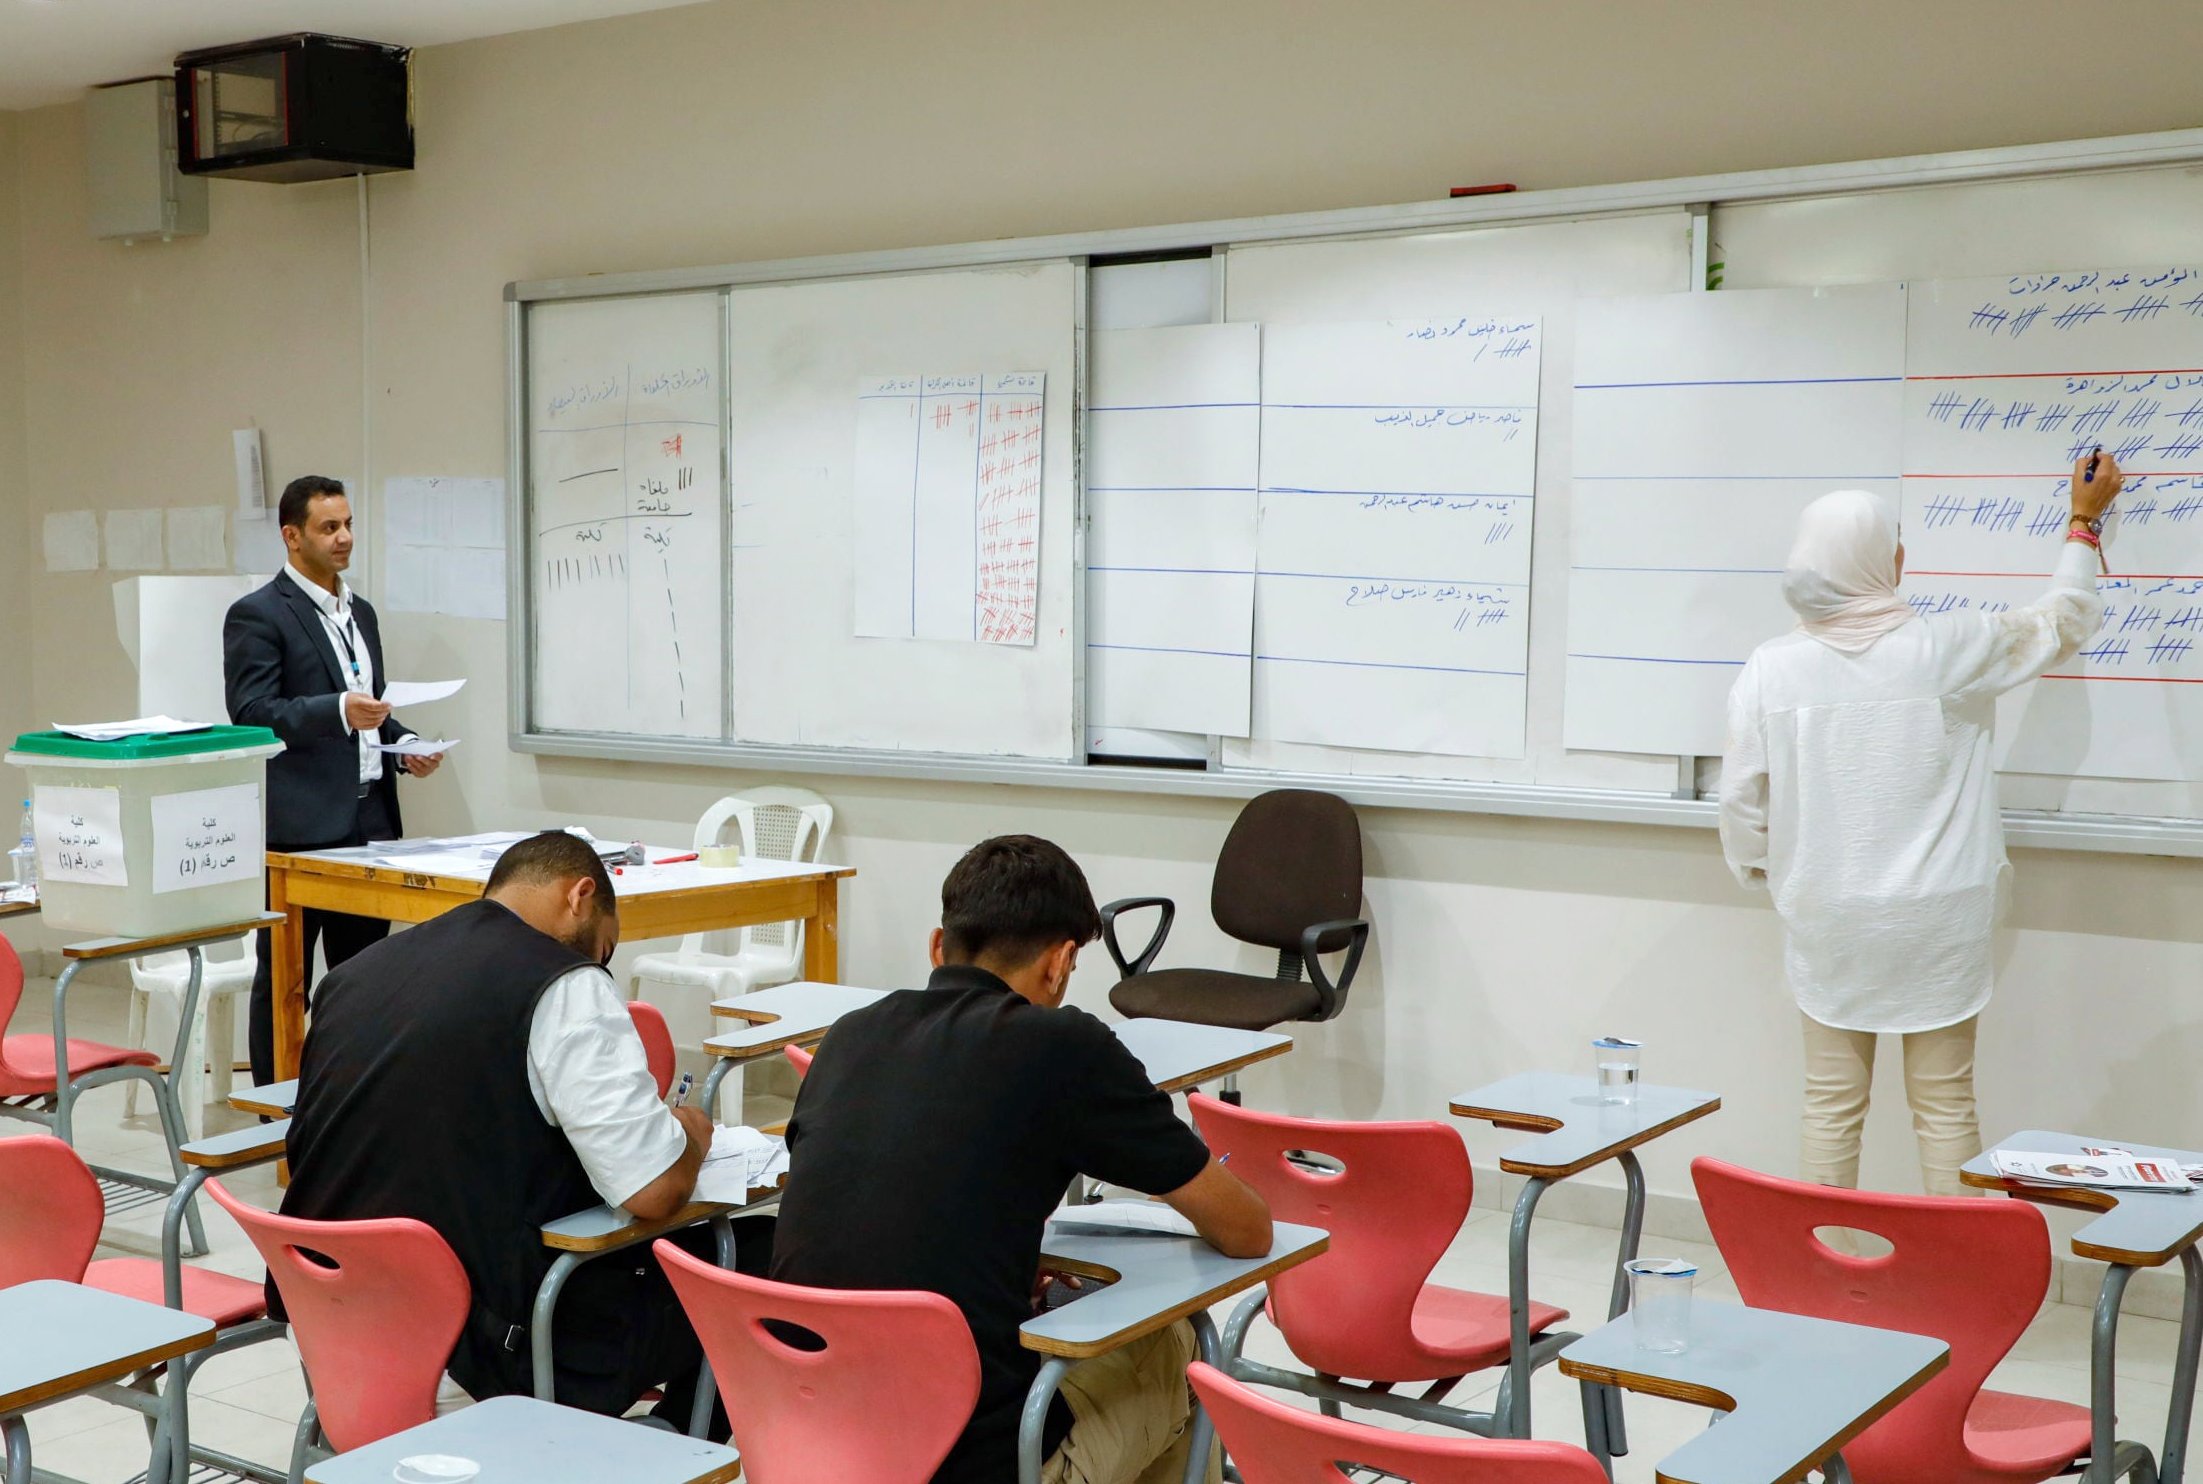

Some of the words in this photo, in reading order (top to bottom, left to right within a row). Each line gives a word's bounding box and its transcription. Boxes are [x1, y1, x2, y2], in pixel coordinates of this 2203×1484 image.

[2062, 271, 2100, 294] الرحمن
[2106, 273, 2130, 291] عبد
[1468, 319, 1496, 339] خليل
[2127, 374, 2158, 393] محمد
[2165, 375, 2203, 390] لال
[1416, 408, 1445, 427] جميل
[1408, 493, 1444, 513] هاشم
[1346, 584, 1389, 606] صلاح
[1391, 585, 1427, 600] فارس
[1434, 585, 1461, 602] زهير
[1467, 587, 1510, 605] شيماء
[71, 815, 84, 829] كلية
[202, 817, 217, 831] كلية
[185, 835, 214, 850] التربوية
[215, 832, 236, 847] العلوم
[74, 852, 88, 870] رقم
[91, 859, 103, 869] ص
[180, 857, 197, 877] (1)
[201, 852, 217, 873] رقم
[220, 855, 236, 868] ص
